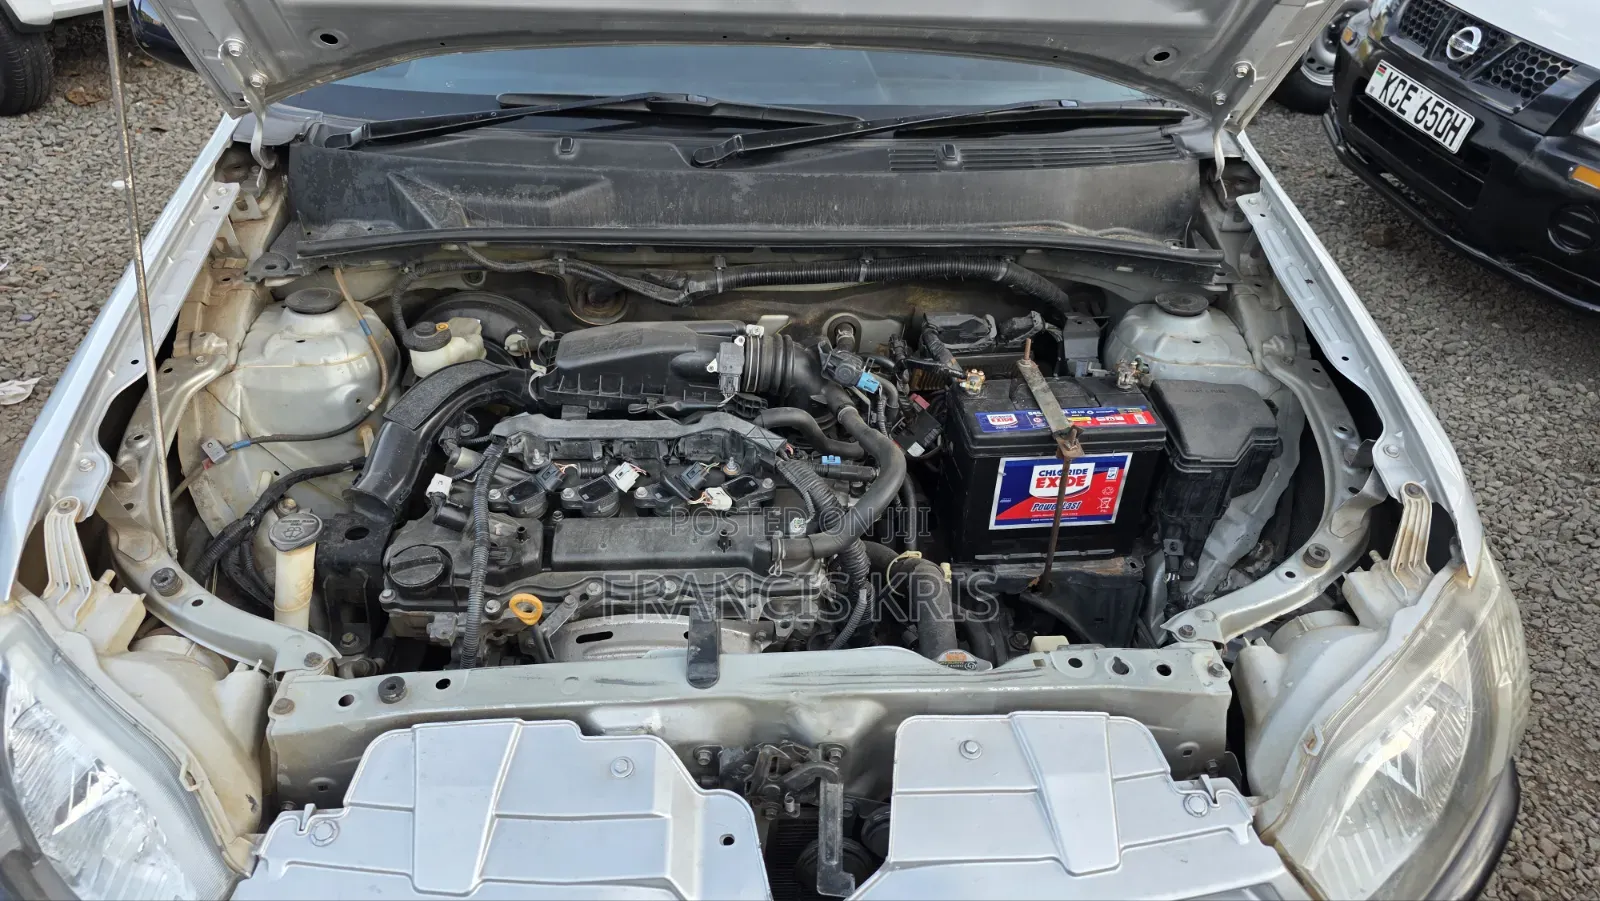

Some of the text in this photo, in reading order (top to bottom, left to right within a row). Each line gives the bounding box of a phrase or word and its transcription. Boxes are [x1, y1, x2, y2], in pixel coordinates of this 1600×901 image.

[1379, 71, 1467, 147] KCE 650H
[1035, 475, 1087, 489] EXDE
